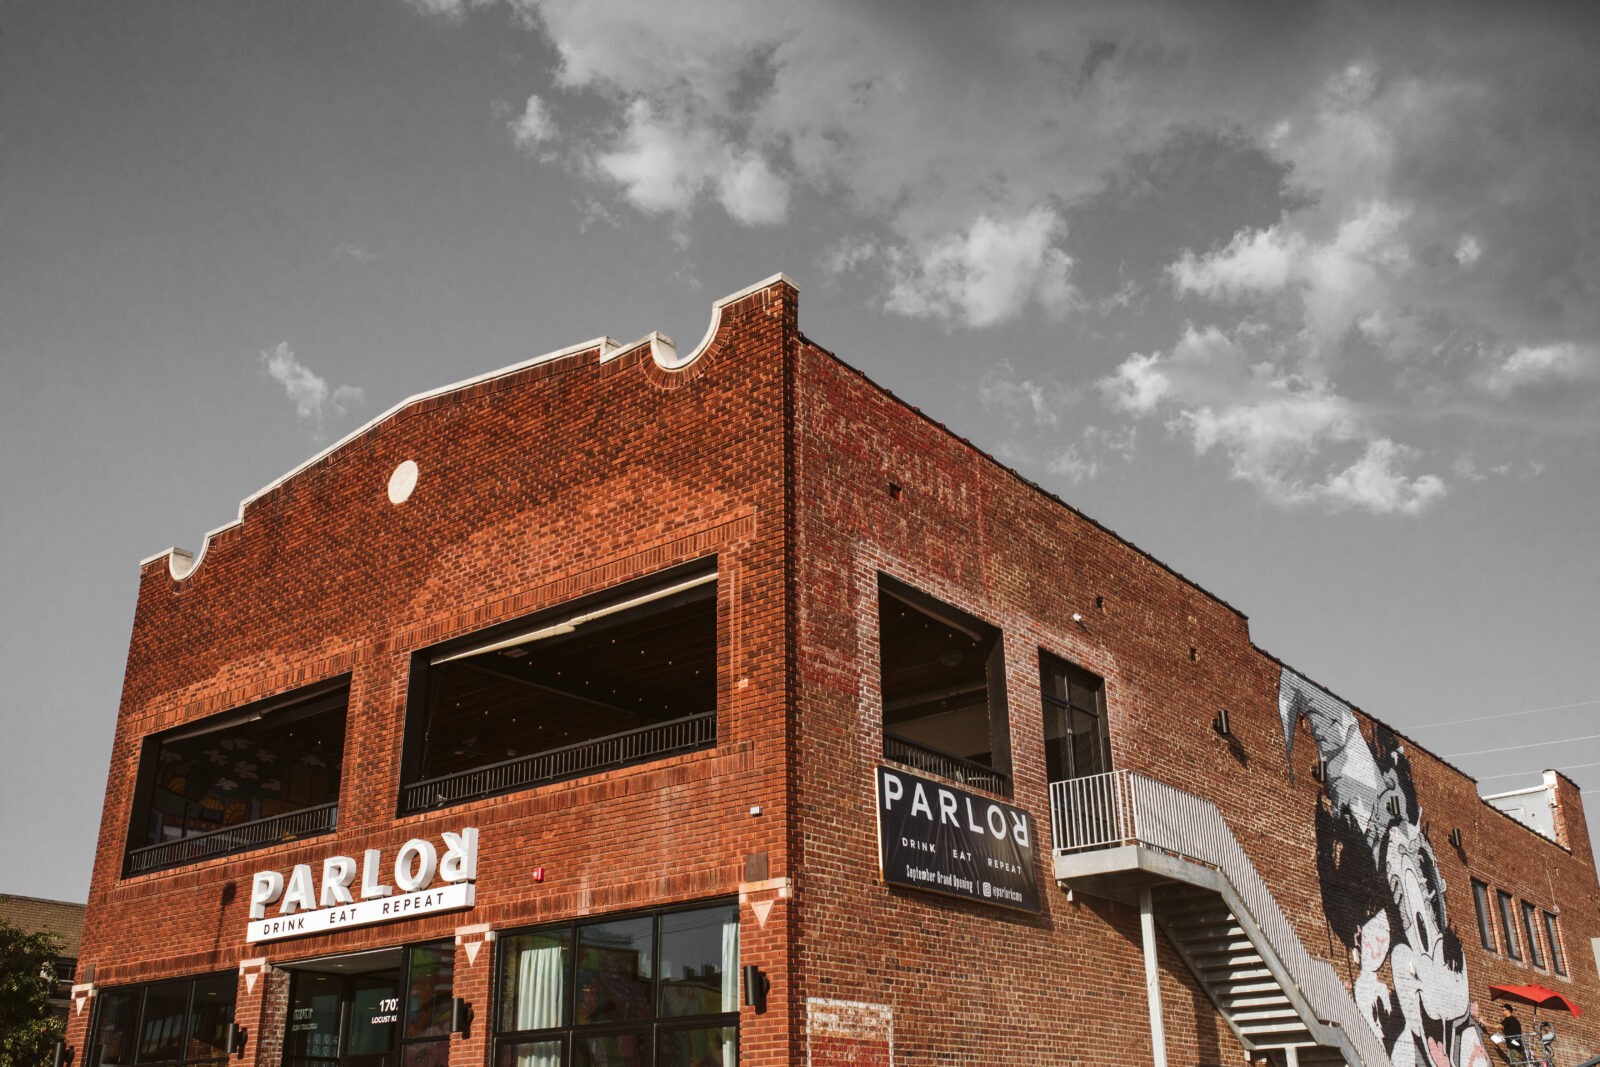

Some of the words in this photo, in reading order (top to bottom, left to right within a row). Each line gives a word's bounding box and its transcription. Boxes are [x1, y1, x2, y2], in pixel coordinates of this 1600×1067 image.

[883, 772, 1030, 848] PARLOR
[249, 827, 480, 919] PARLOR
[902, 837, 936, 853] DRINK
[952, 850, 972, 862] EAT
[987, 858, 1022, 875] REPEAT
[906, 864, 936, 882] September
[937, 870, 952, 886] Grand
[953, 874, 973, 894] Opening
[263, 917, 305, 935] DRINK
[329, 908, 357, 924] EAT
[382, 892, 444, 915] REPEAT
[371, 1015, 391, 1024] LOCUST
